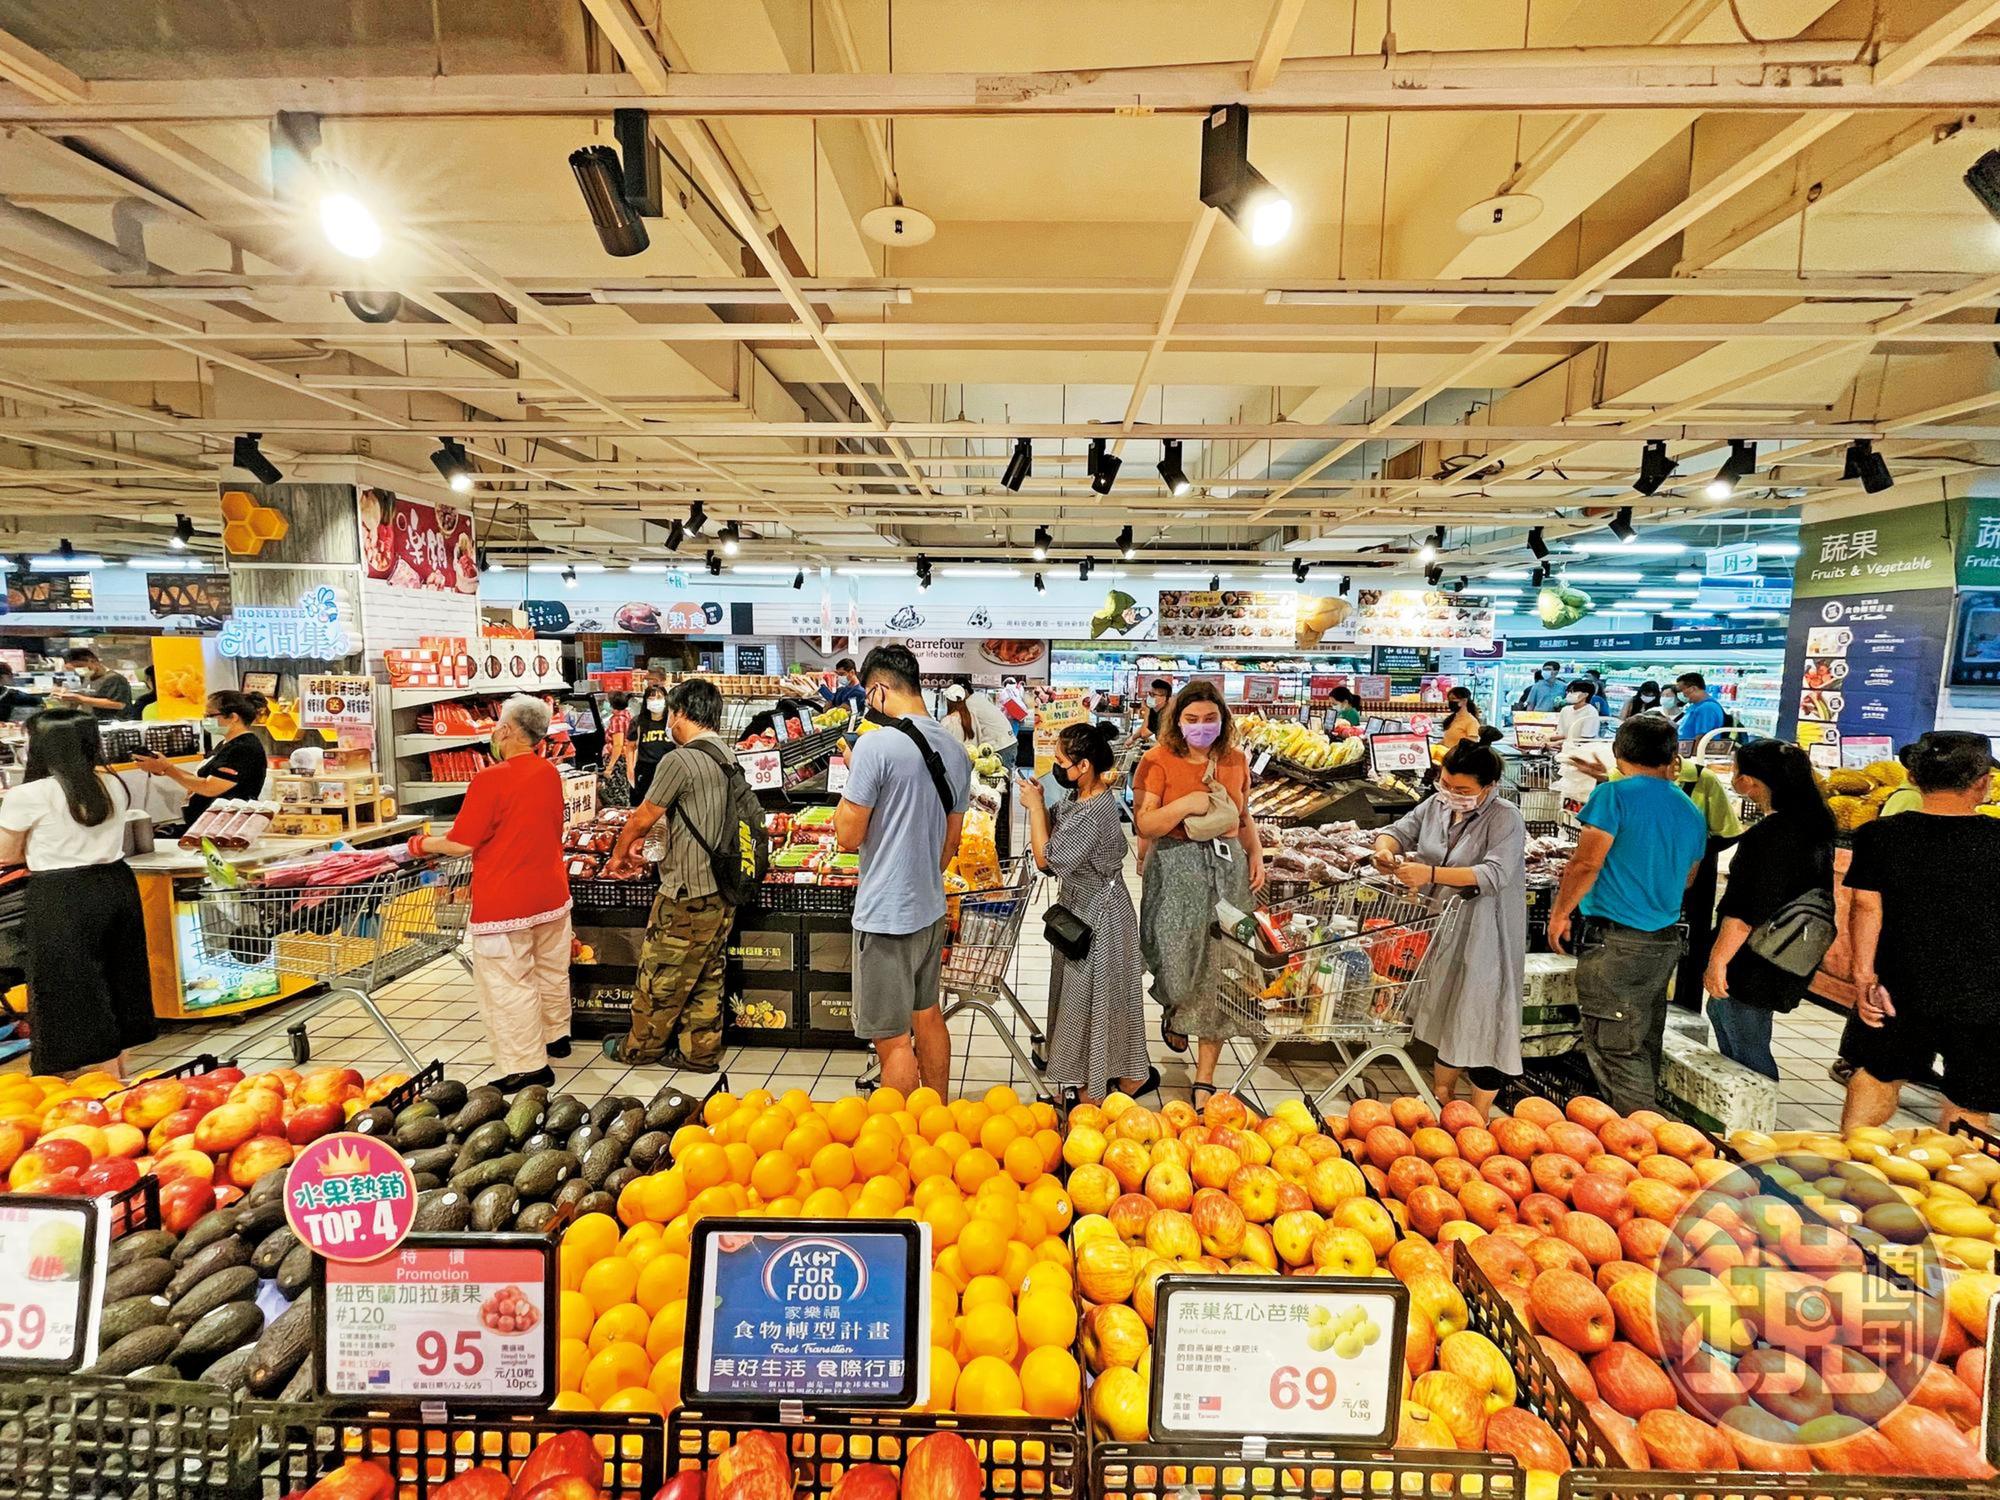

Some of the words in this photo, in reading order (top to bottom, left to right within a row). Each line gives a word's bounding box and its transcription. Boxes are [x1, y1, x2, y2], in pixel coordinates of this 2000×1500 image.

[1820, 530, 1877, 563] 蔬果
[1811, 569, 1846, 580] Fruits
[1850, 565, 1861, 577] &
[1867, 556, 1932, 577] Vegetable
[1752, 579, 1765, 588] 14
[237, 609, 306, 619] HONEYBEE
[238, 621, 330, 658] 花間集
[906, 638, 965, 650] Carrefour
[1399, 753, 1416, 765] 69
[755, 771, 772, 783] 99
[296, 1173, 405, 1208] 水果熱銷
[396, 1268, 469, 1281] Promotion
[794, 1268, 834, 1284] FOR
[336, 1285, 482, 1304] 紐西蘭加拉蘋果
[787, 1285, 842, 1301] FOOD
[336, 1307, 384, 1324] #120
[785, 1306, 840, 1319] 家樂福
[1178, 1302, 1309, 1322] 燕巢紅心芭樂
[734, 1321, 890, 1340] 食物轉型計畫
[1178, 1327, 1199, 1335] Pearl
[1202, 1327, 1227, 1335] Guava
[416, 1330, 484, 1376] 95
[771, 1343, 798, 1354] Food
[714, 1359, 806, 1378] 美好生活
[506, 1379, 538, 1390] 10pcs
[1269, 1366, 1337, 1411] 69
[1349, 1409, 1371, 1420] bag
